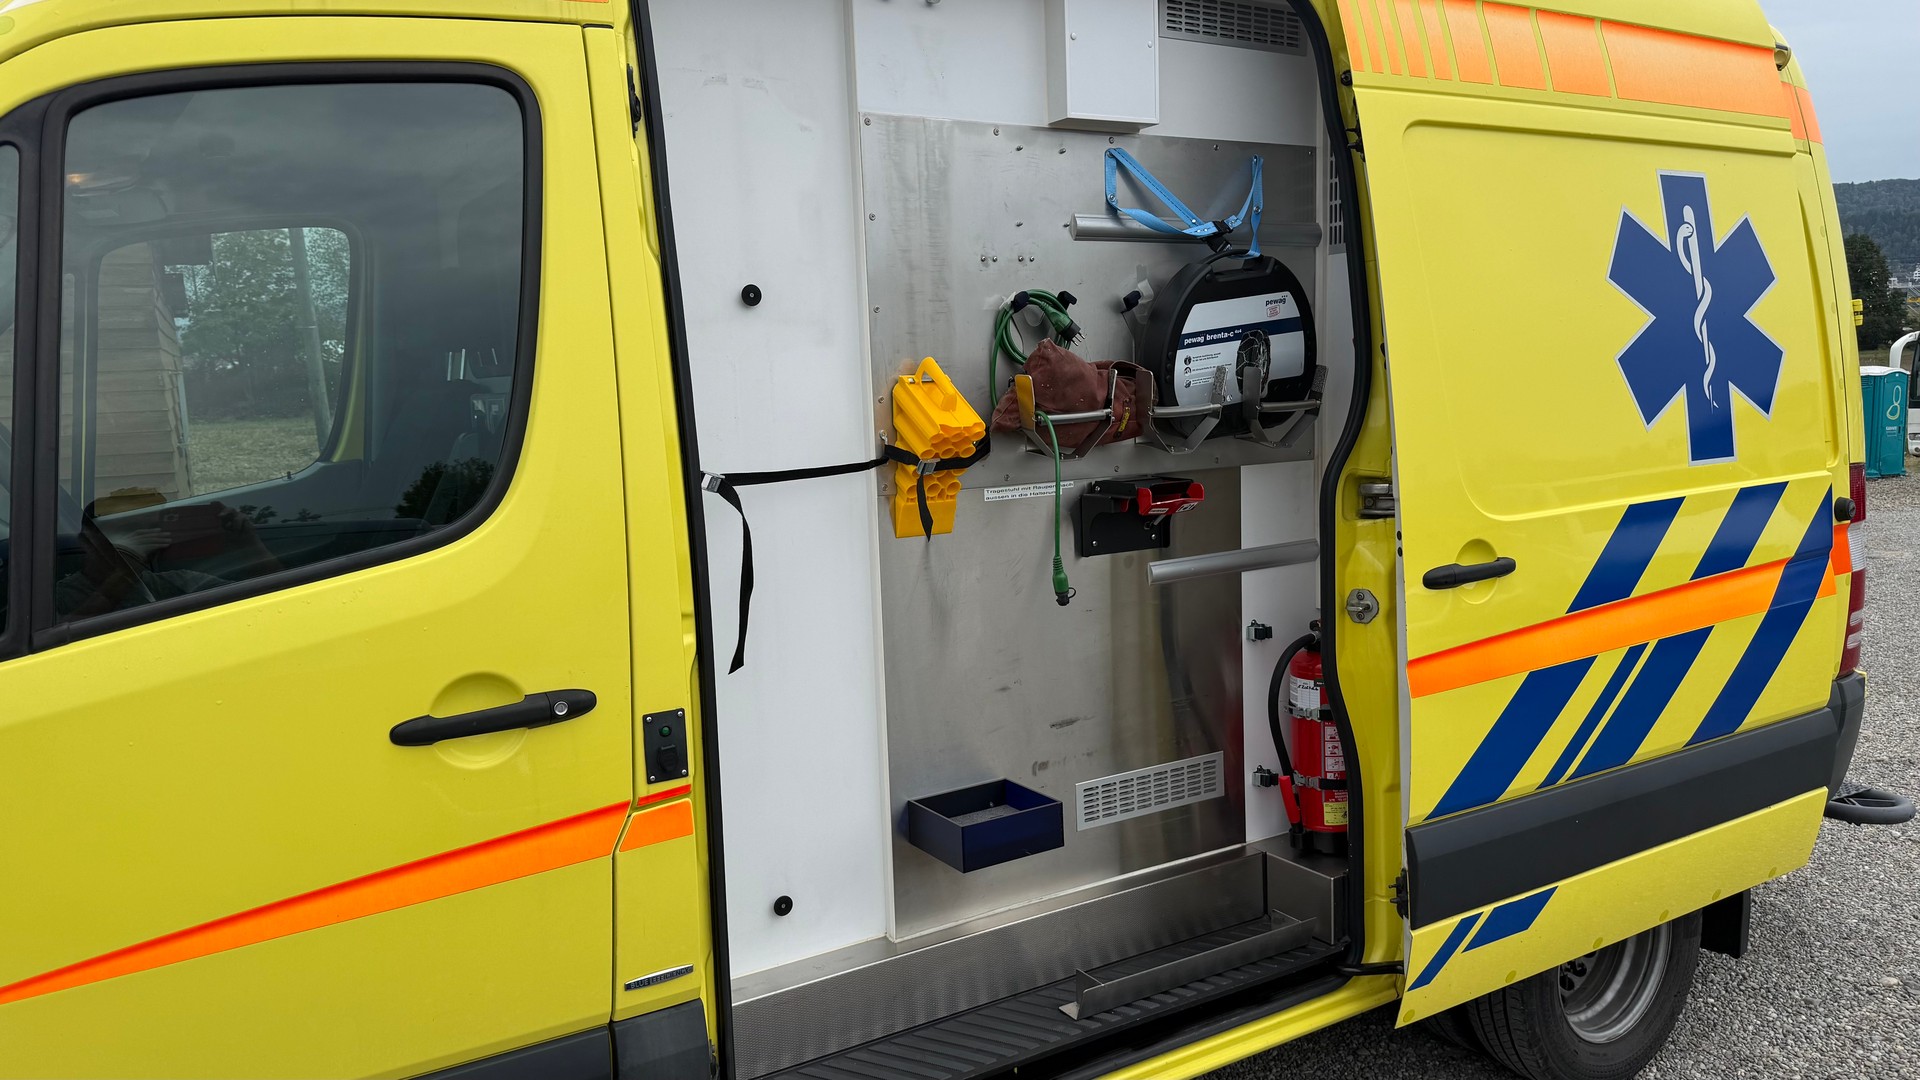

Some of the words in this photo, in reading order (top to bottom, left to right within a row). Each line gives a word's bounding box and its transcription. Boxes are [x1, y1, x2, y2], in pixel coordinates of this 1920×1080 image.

[1265, 297, 1287, 306] pewag
[1184, 335, 1205, 346] pewag
[1206, 331, 1234, 341] brenta-c
